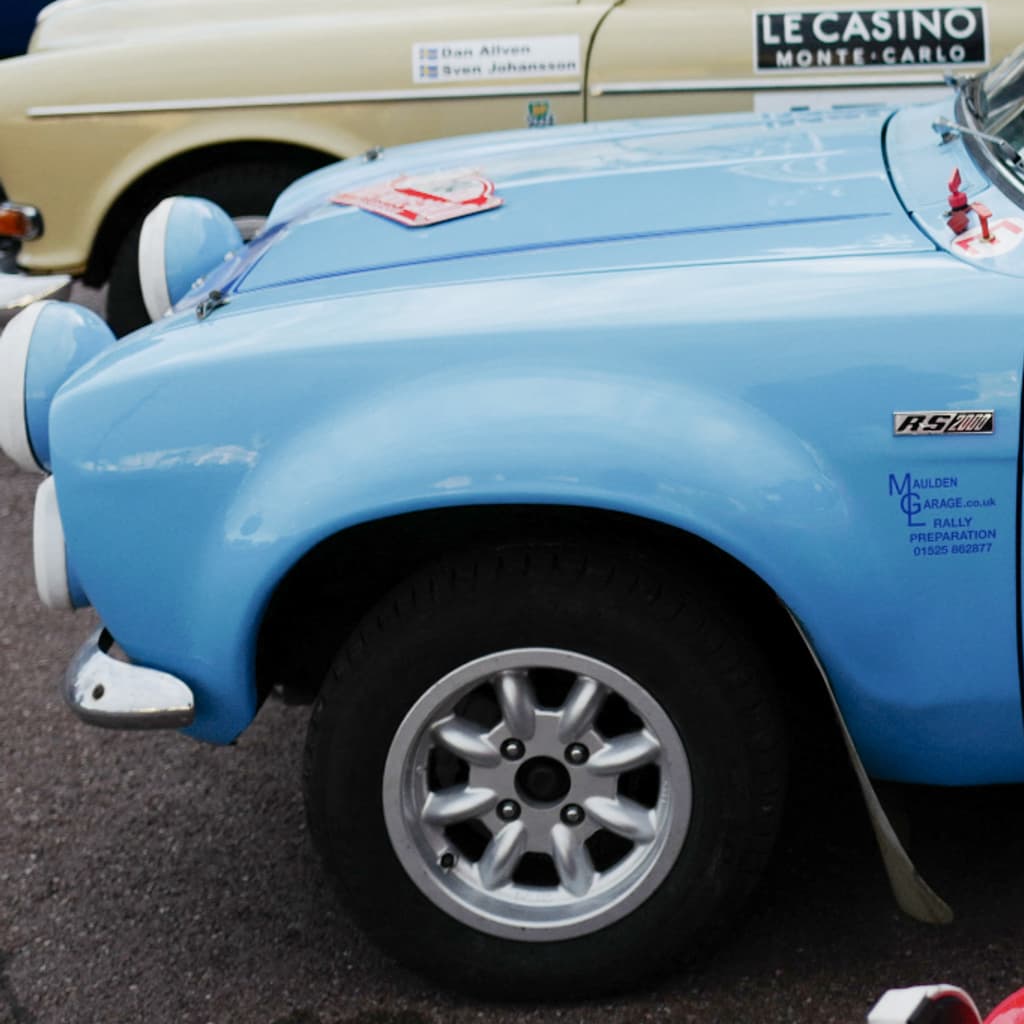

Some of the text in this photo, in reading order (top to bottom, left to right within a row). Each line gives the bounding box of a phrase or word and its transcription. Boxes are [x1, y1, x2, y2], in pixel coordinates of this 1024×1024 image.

[762, 8, 976, 45] LE CASINO
[442, 61, 576, 75] Sven Johansson
[889, 472, 958, 496] MAULDEN
[933, 517, 973, 529] RALLY
[909, 528, 997, 543] PREPARATION
[913, 544, 949, 557] 01525
